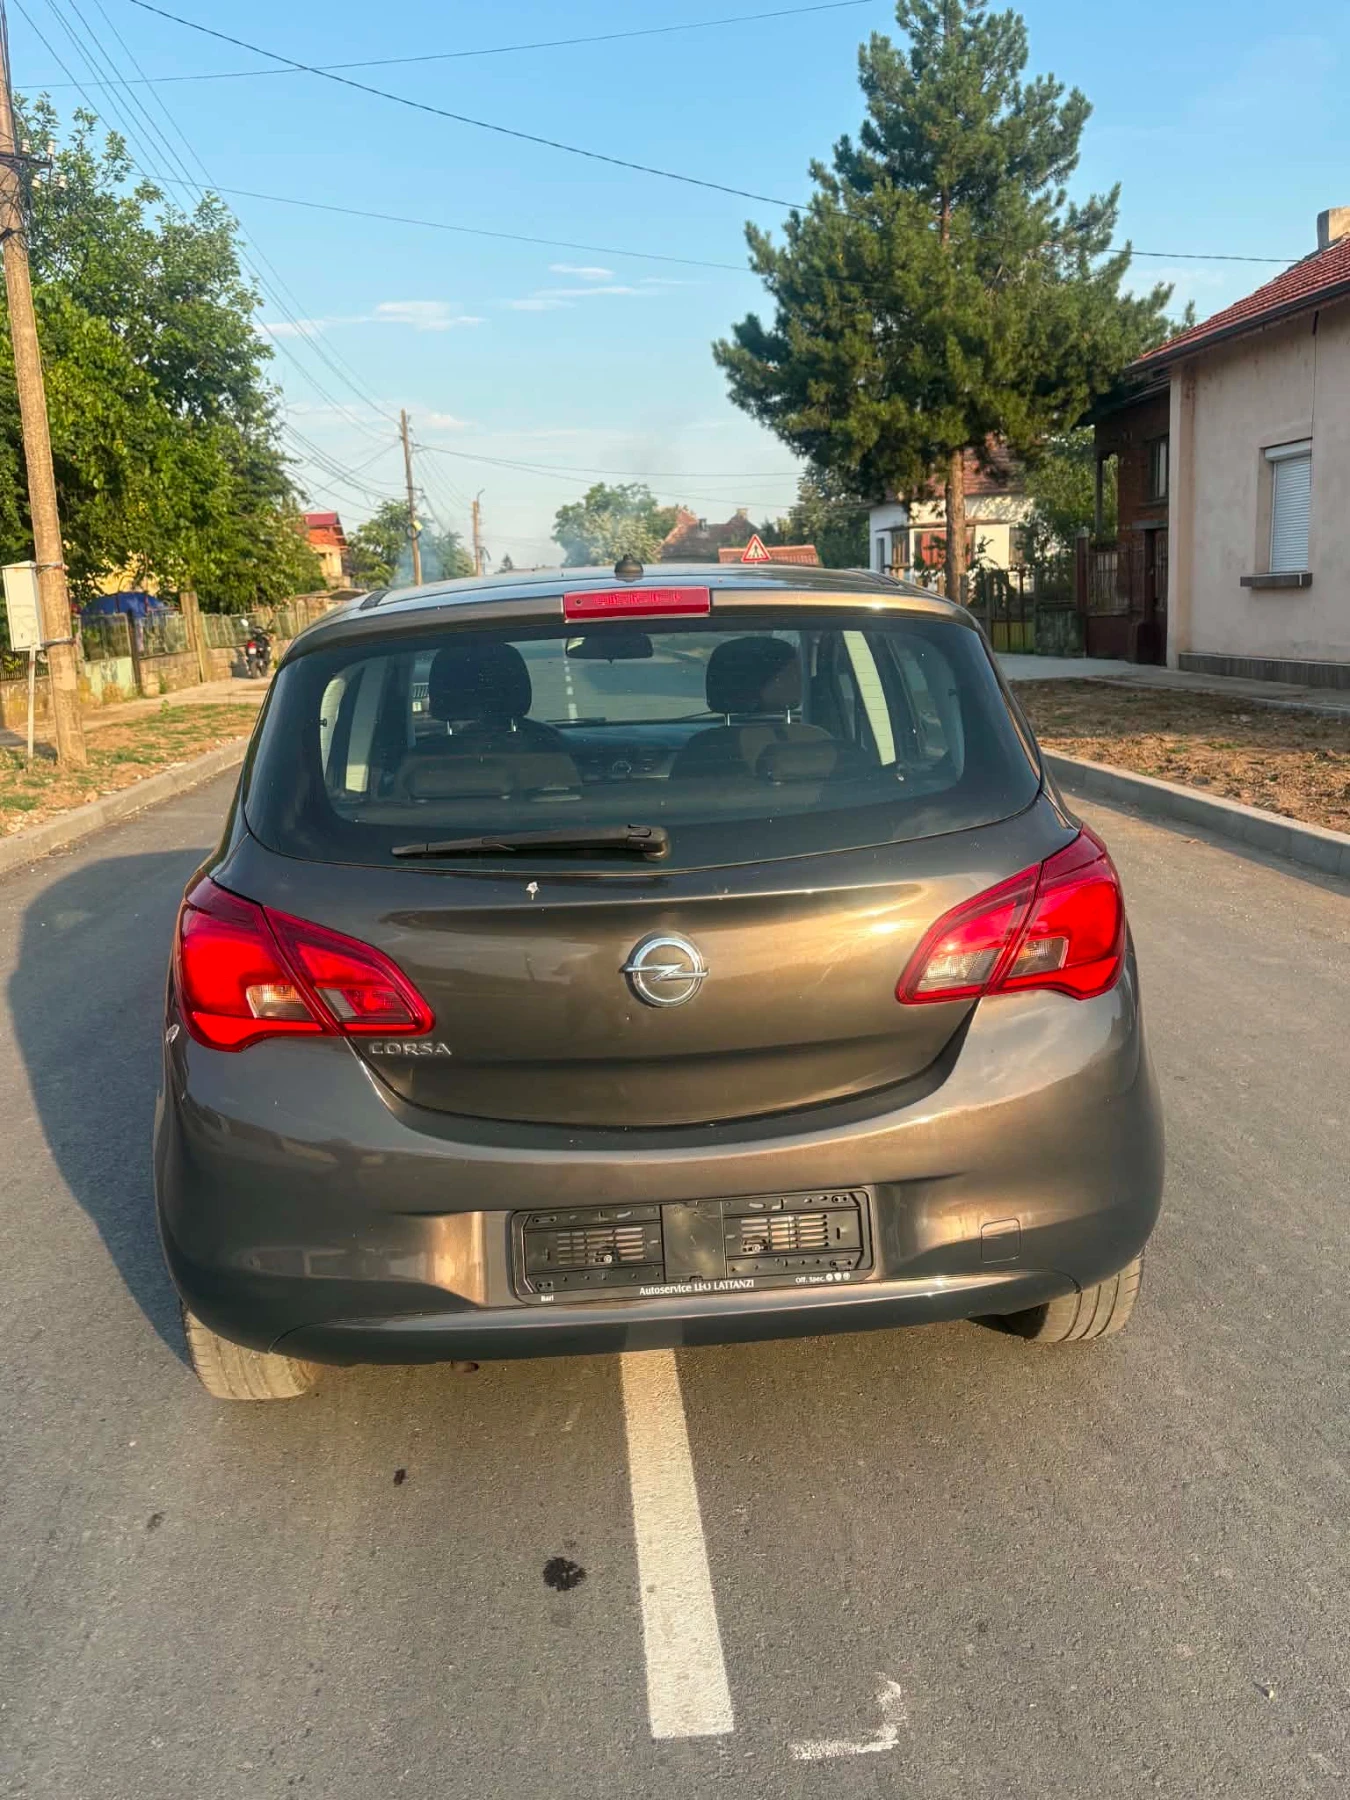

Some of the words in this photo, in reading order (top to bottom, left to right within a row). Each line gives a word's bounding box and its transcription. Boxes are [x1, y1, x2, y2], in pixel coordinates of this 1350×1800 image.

[369, 1042, 452, 1055] CORSA
[639, 1285, 692, 1295] Autoservice
[713, 1279, 755, 1290] LATTANZI
